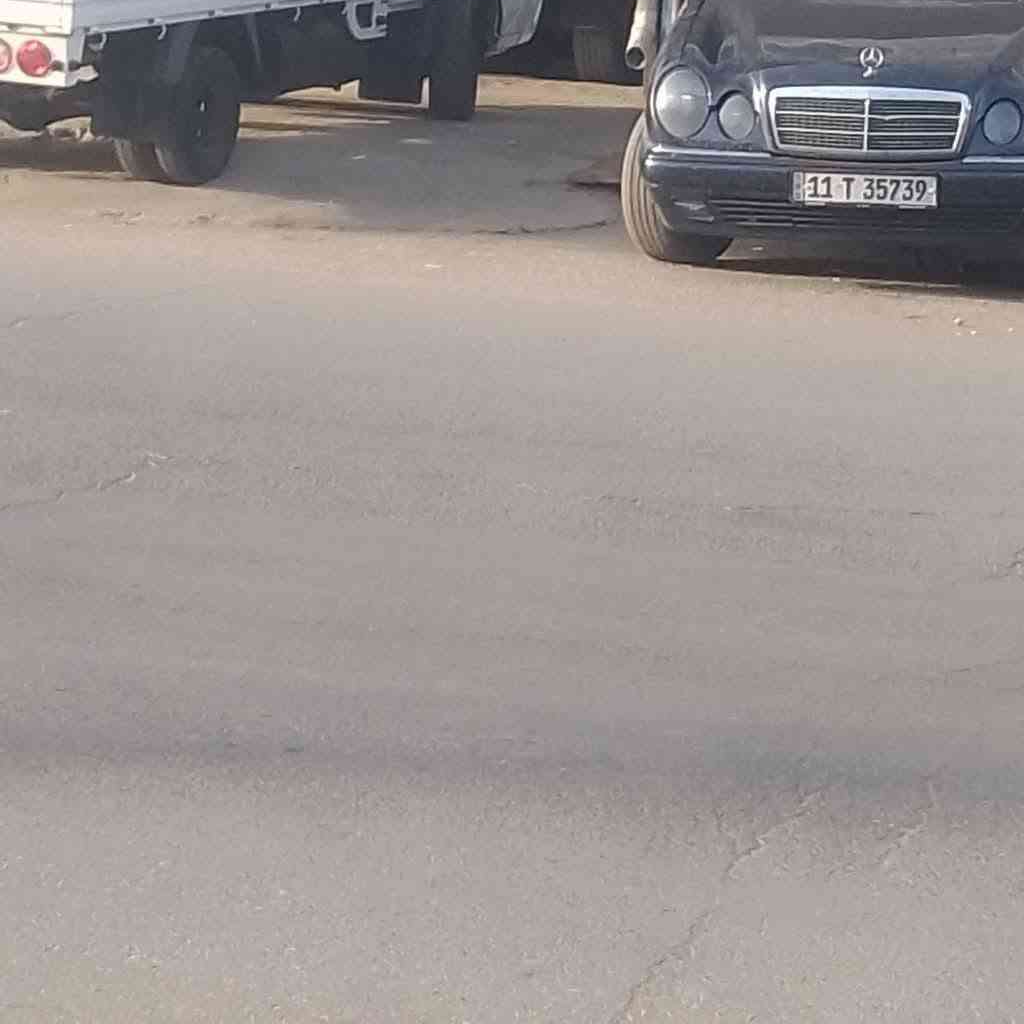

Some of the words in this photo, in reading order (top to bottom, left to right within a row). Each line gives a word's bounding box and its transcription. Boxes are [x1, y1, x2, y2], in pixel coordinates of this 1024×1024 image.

[807, 176, 833, 198] 11
[841, 176, 855, 200] T
[862, 178, 928, 201] 35739
